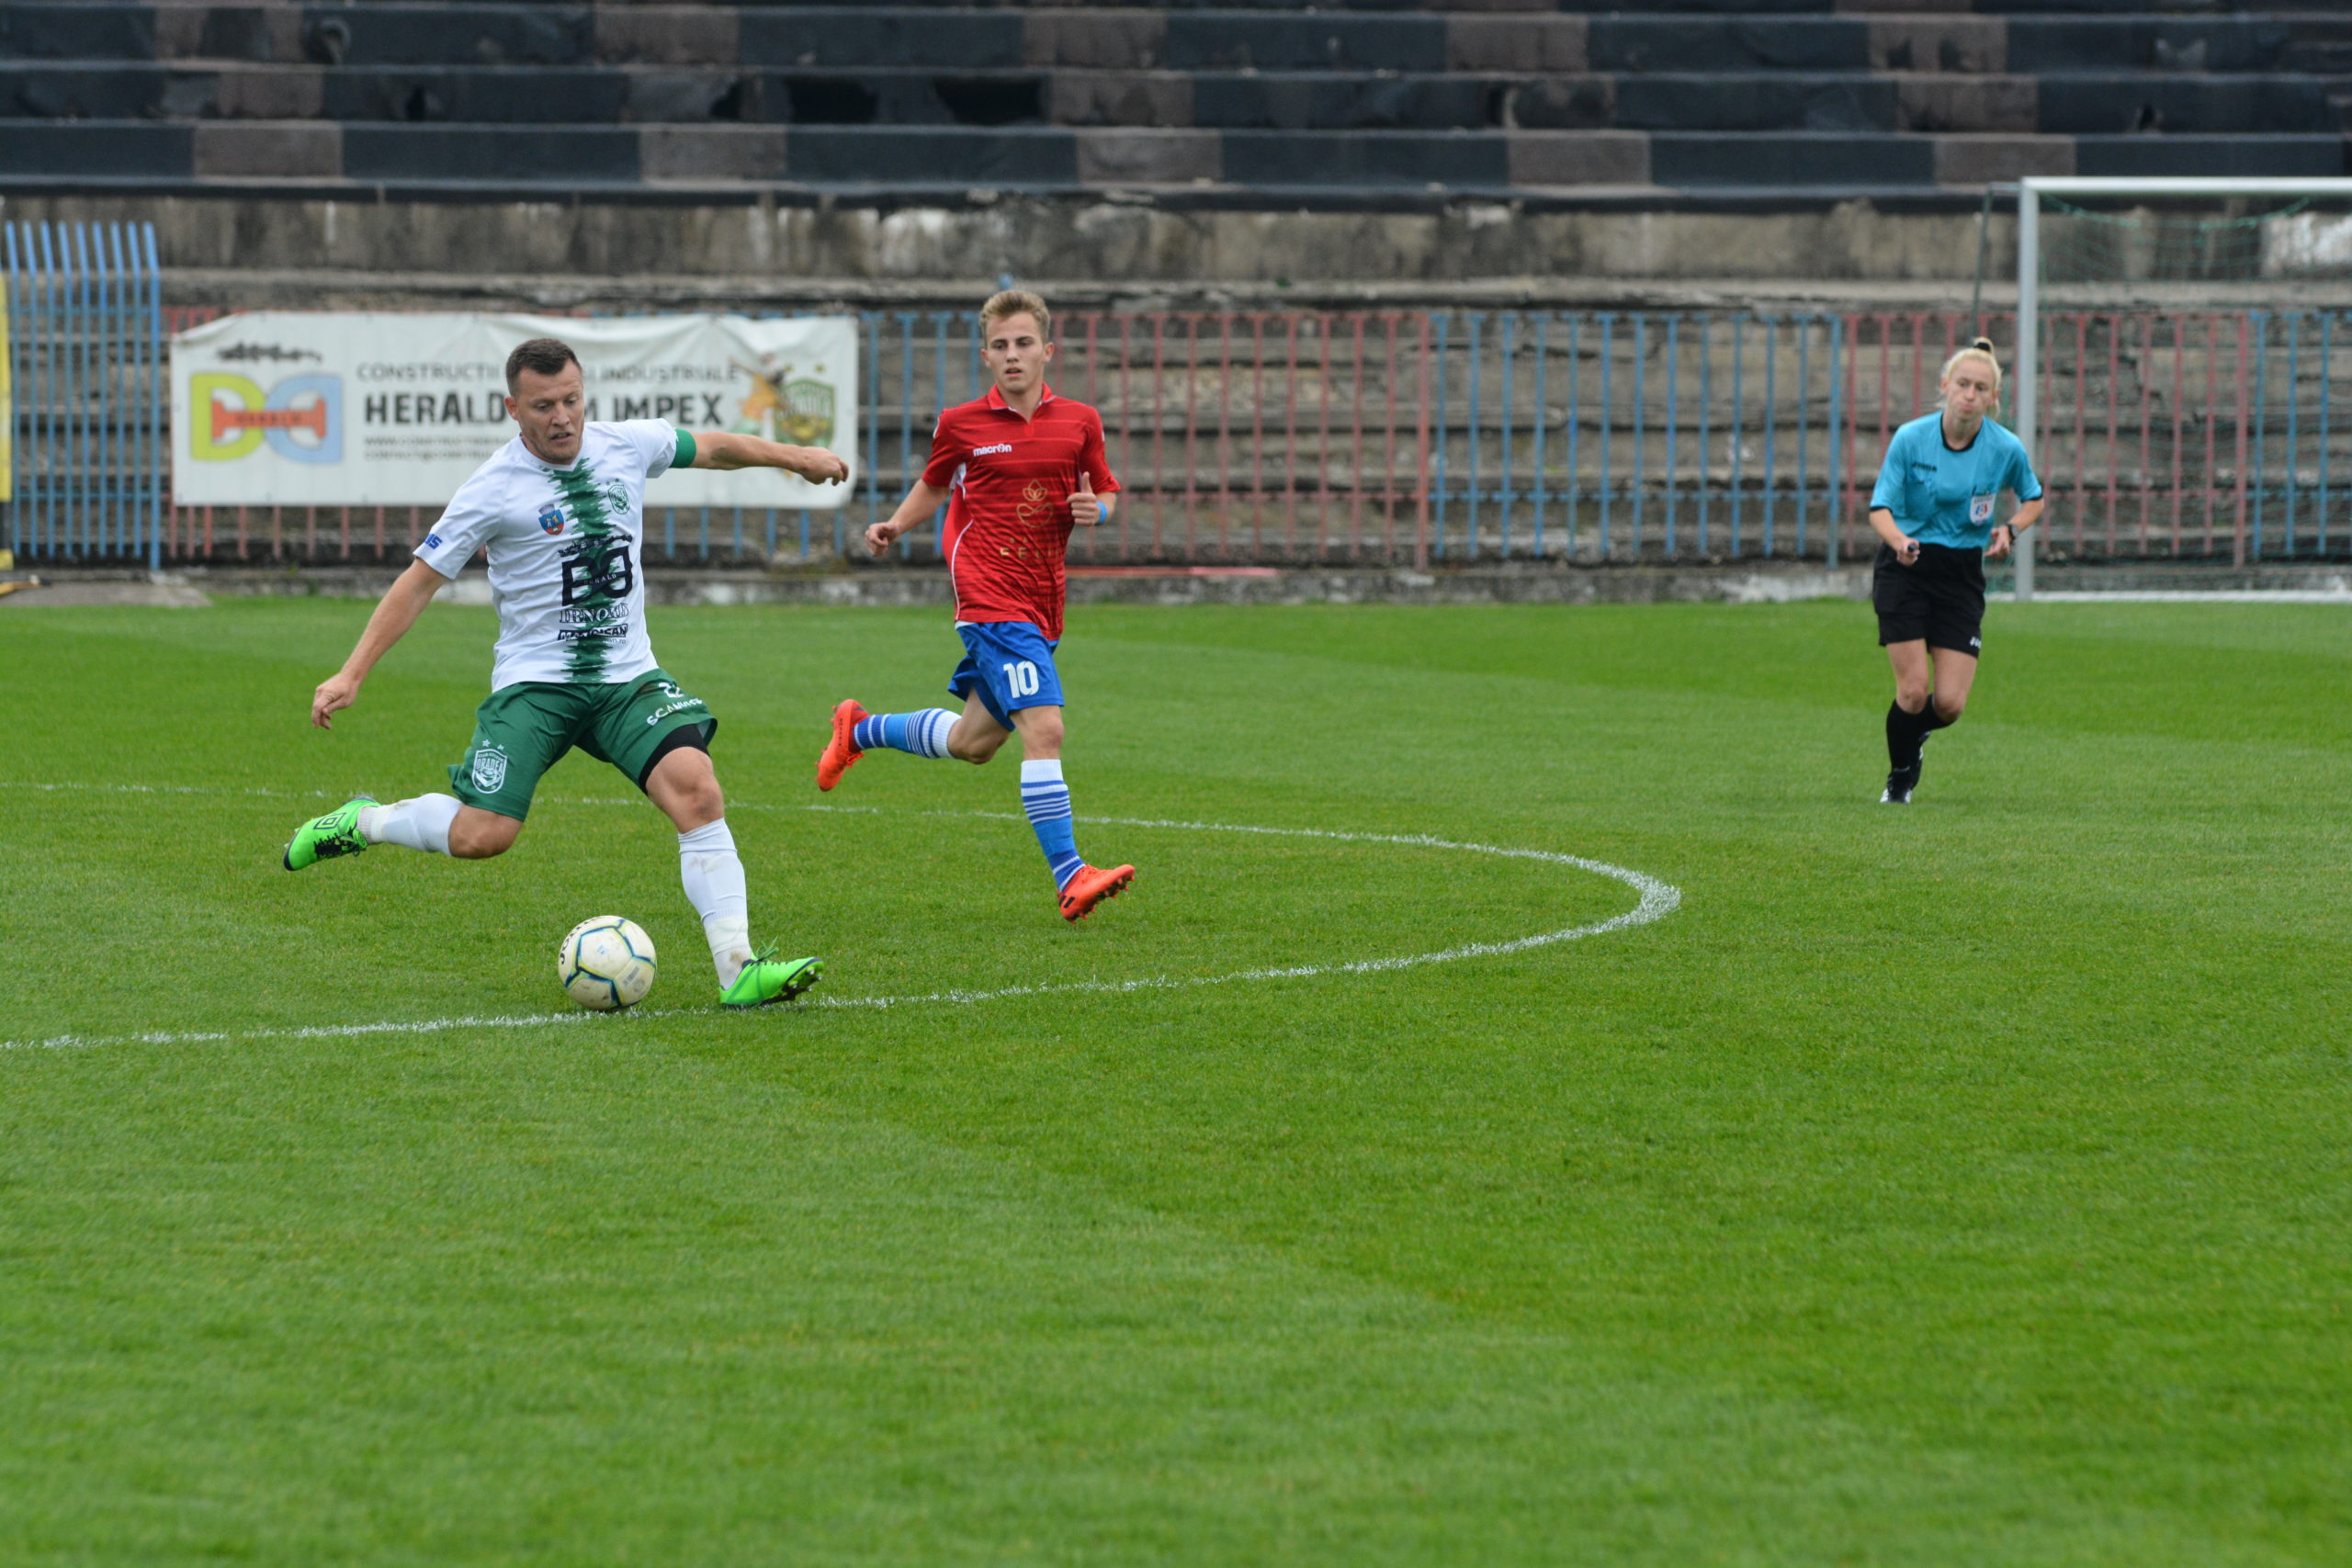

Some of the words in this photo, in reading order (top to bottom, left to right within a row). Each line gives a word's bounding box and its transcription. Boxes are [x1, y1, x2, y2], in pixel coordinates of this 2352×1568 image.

[612, 392, 722, 425] IMPEX
[973, 443, 1012, 457] macron
[1003, 660, 1039, 698] 10
